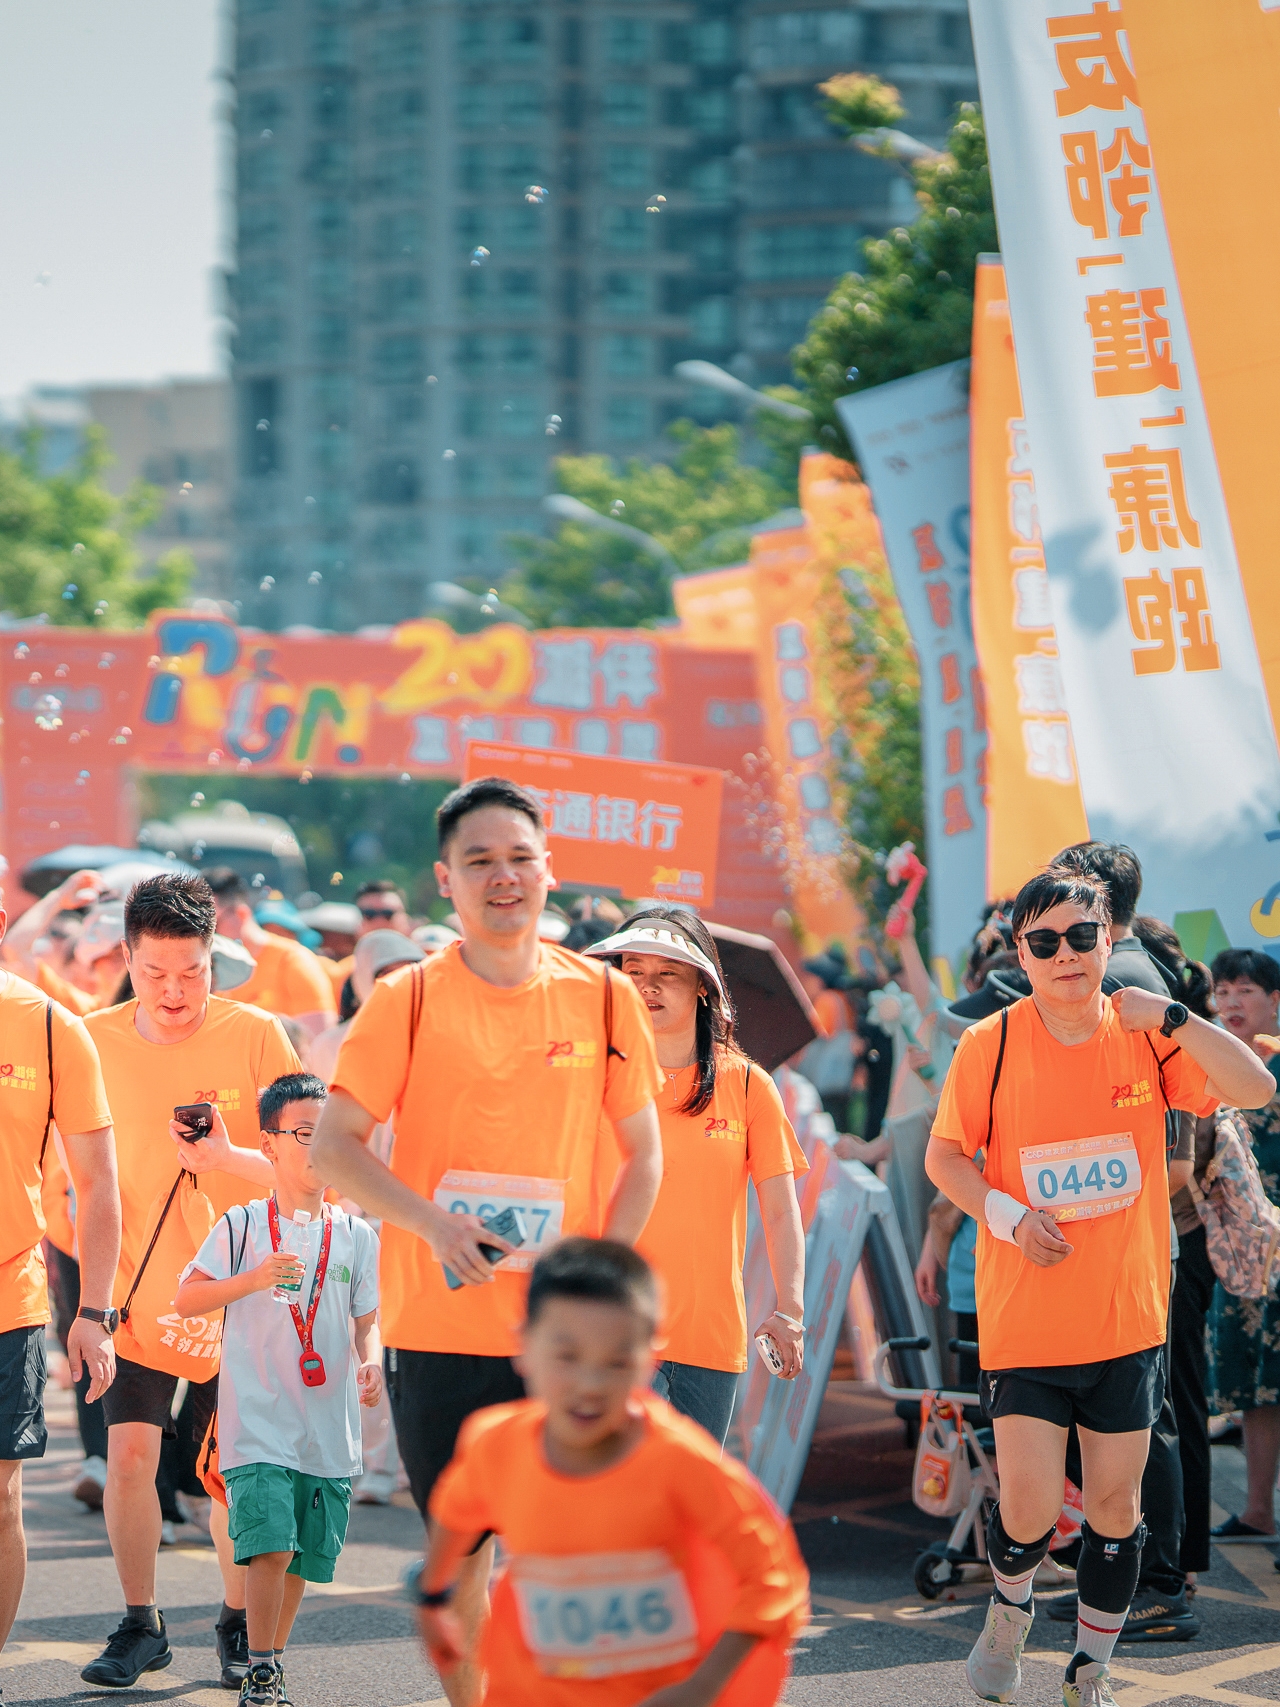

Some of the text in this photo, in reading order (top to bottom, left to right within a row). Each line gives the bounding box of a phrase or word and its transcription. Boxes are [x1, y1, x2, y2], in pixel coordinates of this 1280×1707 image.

[1037, 1158, 1128, 1199] 0449
[325, 1268, 342, 1277] ORTH
[532, 1586, 673, 1646] 1046
